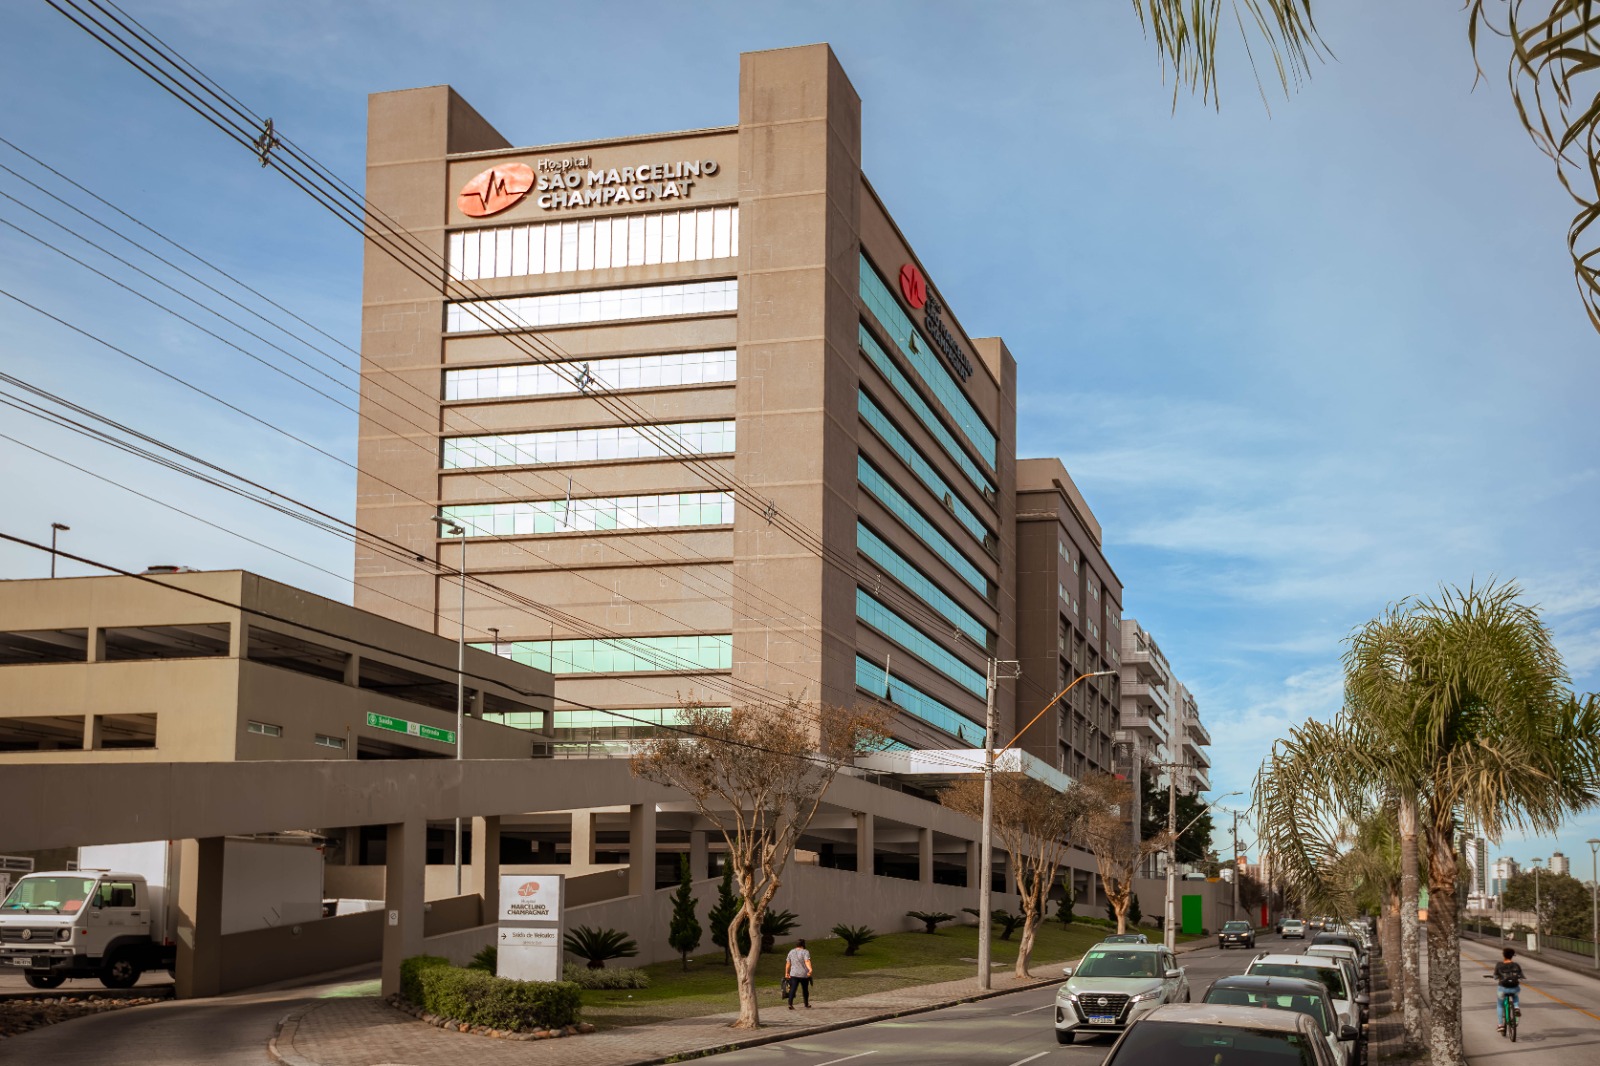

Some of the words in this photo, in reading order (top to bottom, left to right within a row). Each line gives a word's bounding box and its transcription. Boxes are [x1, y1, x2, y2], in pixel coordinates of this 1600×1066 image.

[537, 155, 591, 172] Hospital
[537, 171, 581, 191] SÃO
[587, 160, 718, 186] MARCELINO
[537, 180, 693, 209] CHAMPAGNAT
